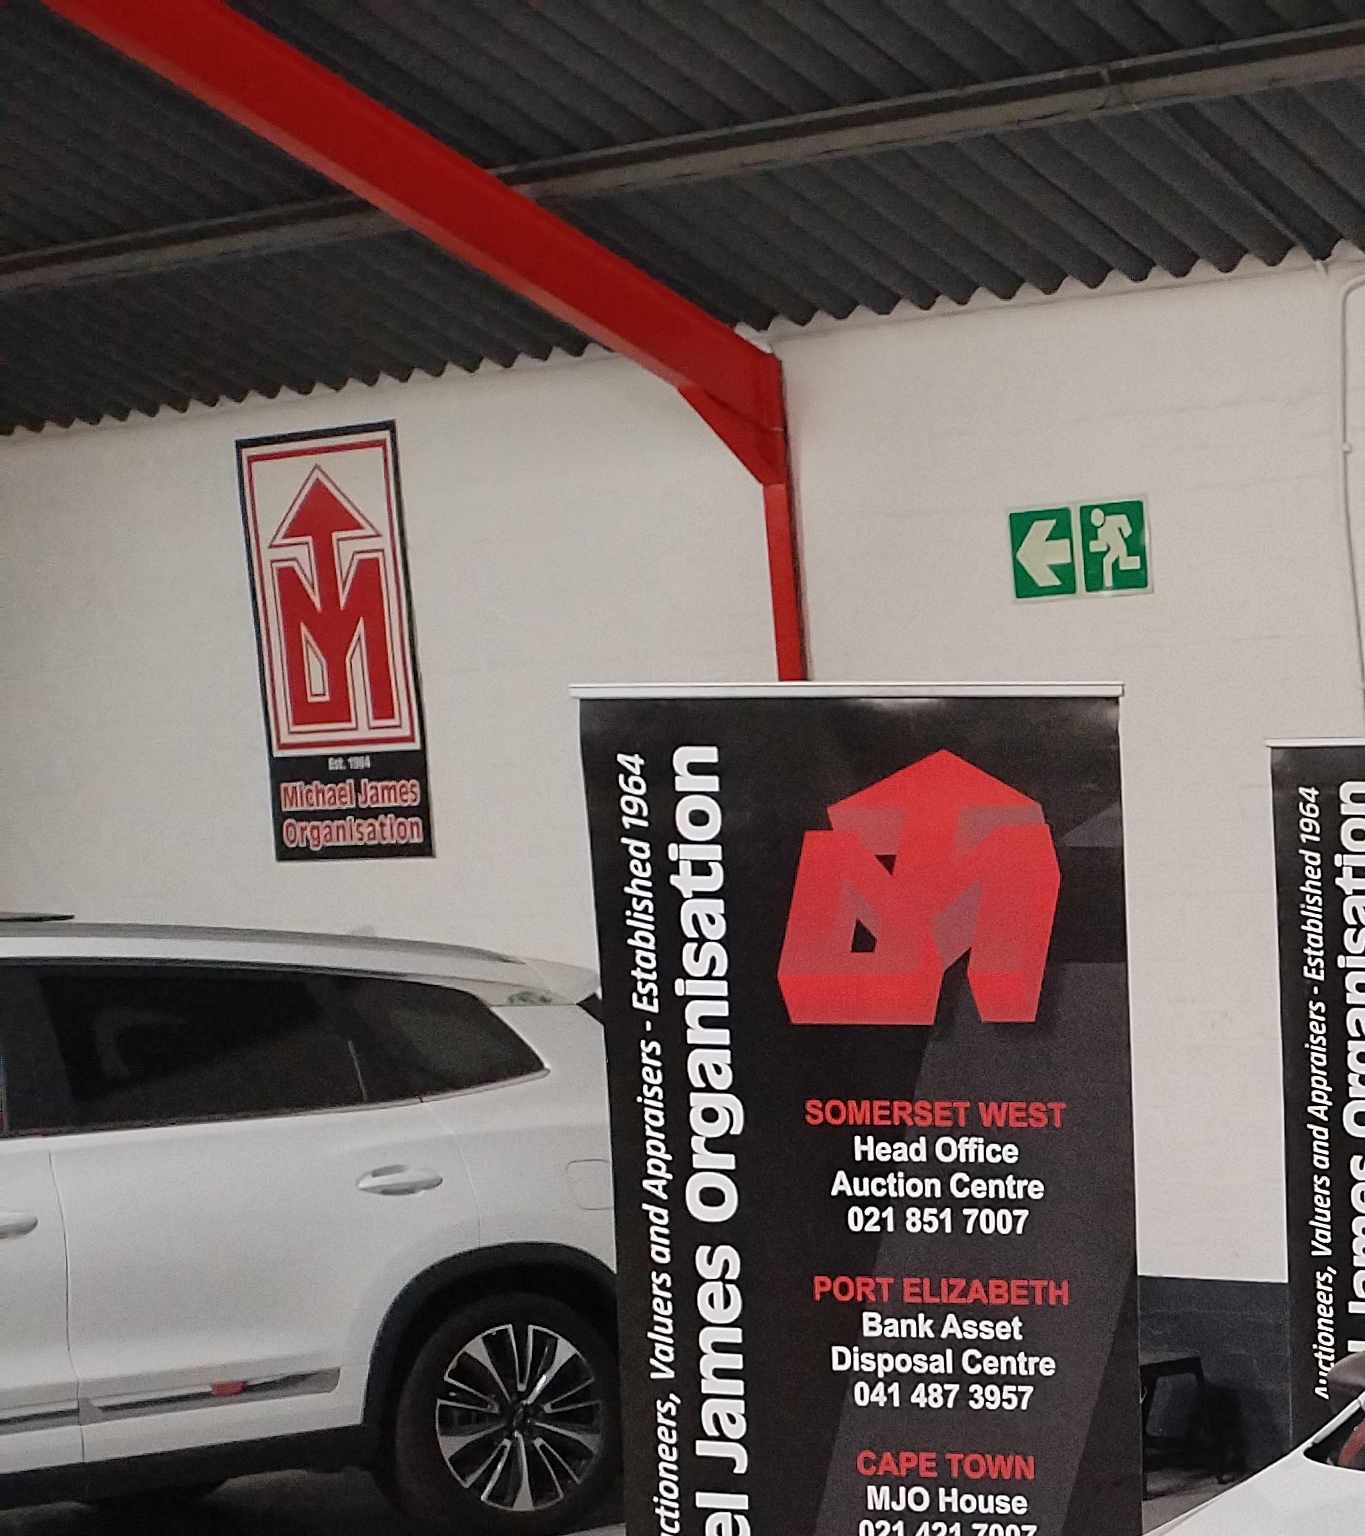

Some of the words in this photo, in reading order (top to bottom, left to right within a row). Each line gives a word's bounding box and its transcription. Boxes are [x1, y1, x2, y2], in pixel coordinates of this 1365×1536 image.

[280, 779, 355, 812] Michael
[358, 778, 421, 808] James
[616, 753, 649, 830] 1964
[283, 813, 424, 851] Organisation
[1298, 786, 1321, 844] 1964
[620, 836, 660, 1014] Established
[1298, 848, 1325, 982] Established
[667, 745, 745, 1223] Organisation
[1304, 1000, 1333, 1122] Appraisers
[636, 1039, 674, 1201] Appraisers
[805, 1098, 971, 1128] SOMERSET
[978, 1101, 1067, 1129] WEST
[853, 1135, 927, 1163] Head
[934, 1136, 1019, 1164] Office
[1306, 1123, 1330, 1170] and
[830, 1170, 942, 1198] Auction
[949, 1172, 1045, 1200] Centre
[641, 1202, 671, 1264] and
[847, 1205, 895, 1233] 021
[905, 1206, 952, 1234] 851
[962, 1208, 1030, 1235] 7007
[1308, 1174, 1333, 1256] Valuers
[813, 1275, 895, 1303] PORT
[903, 1277, 1069, 1306] ELIZABETH
[646, 1270, 675, 1379] Valuers
[862, 1311, 935, 1339] Bank
[940, 1313, 1024, 1341] Asset
[695, 1244, 749, 1474] James
[831, 1345, 953, 1379] Disposal
[961, 1348, 1056, 1377] Centre
[853, 1381, 900, 1408] 041
[910, 1382, 960, 1409] 487
[968, 1383, 1034, 1411] 3957
[856, 1449, 938, 1478] CAPE
[945, 1452, 1035, 1480] TOWN
[866, 1485, 931, 1512] MJO
[938, 1487, 1028, 1515] House
